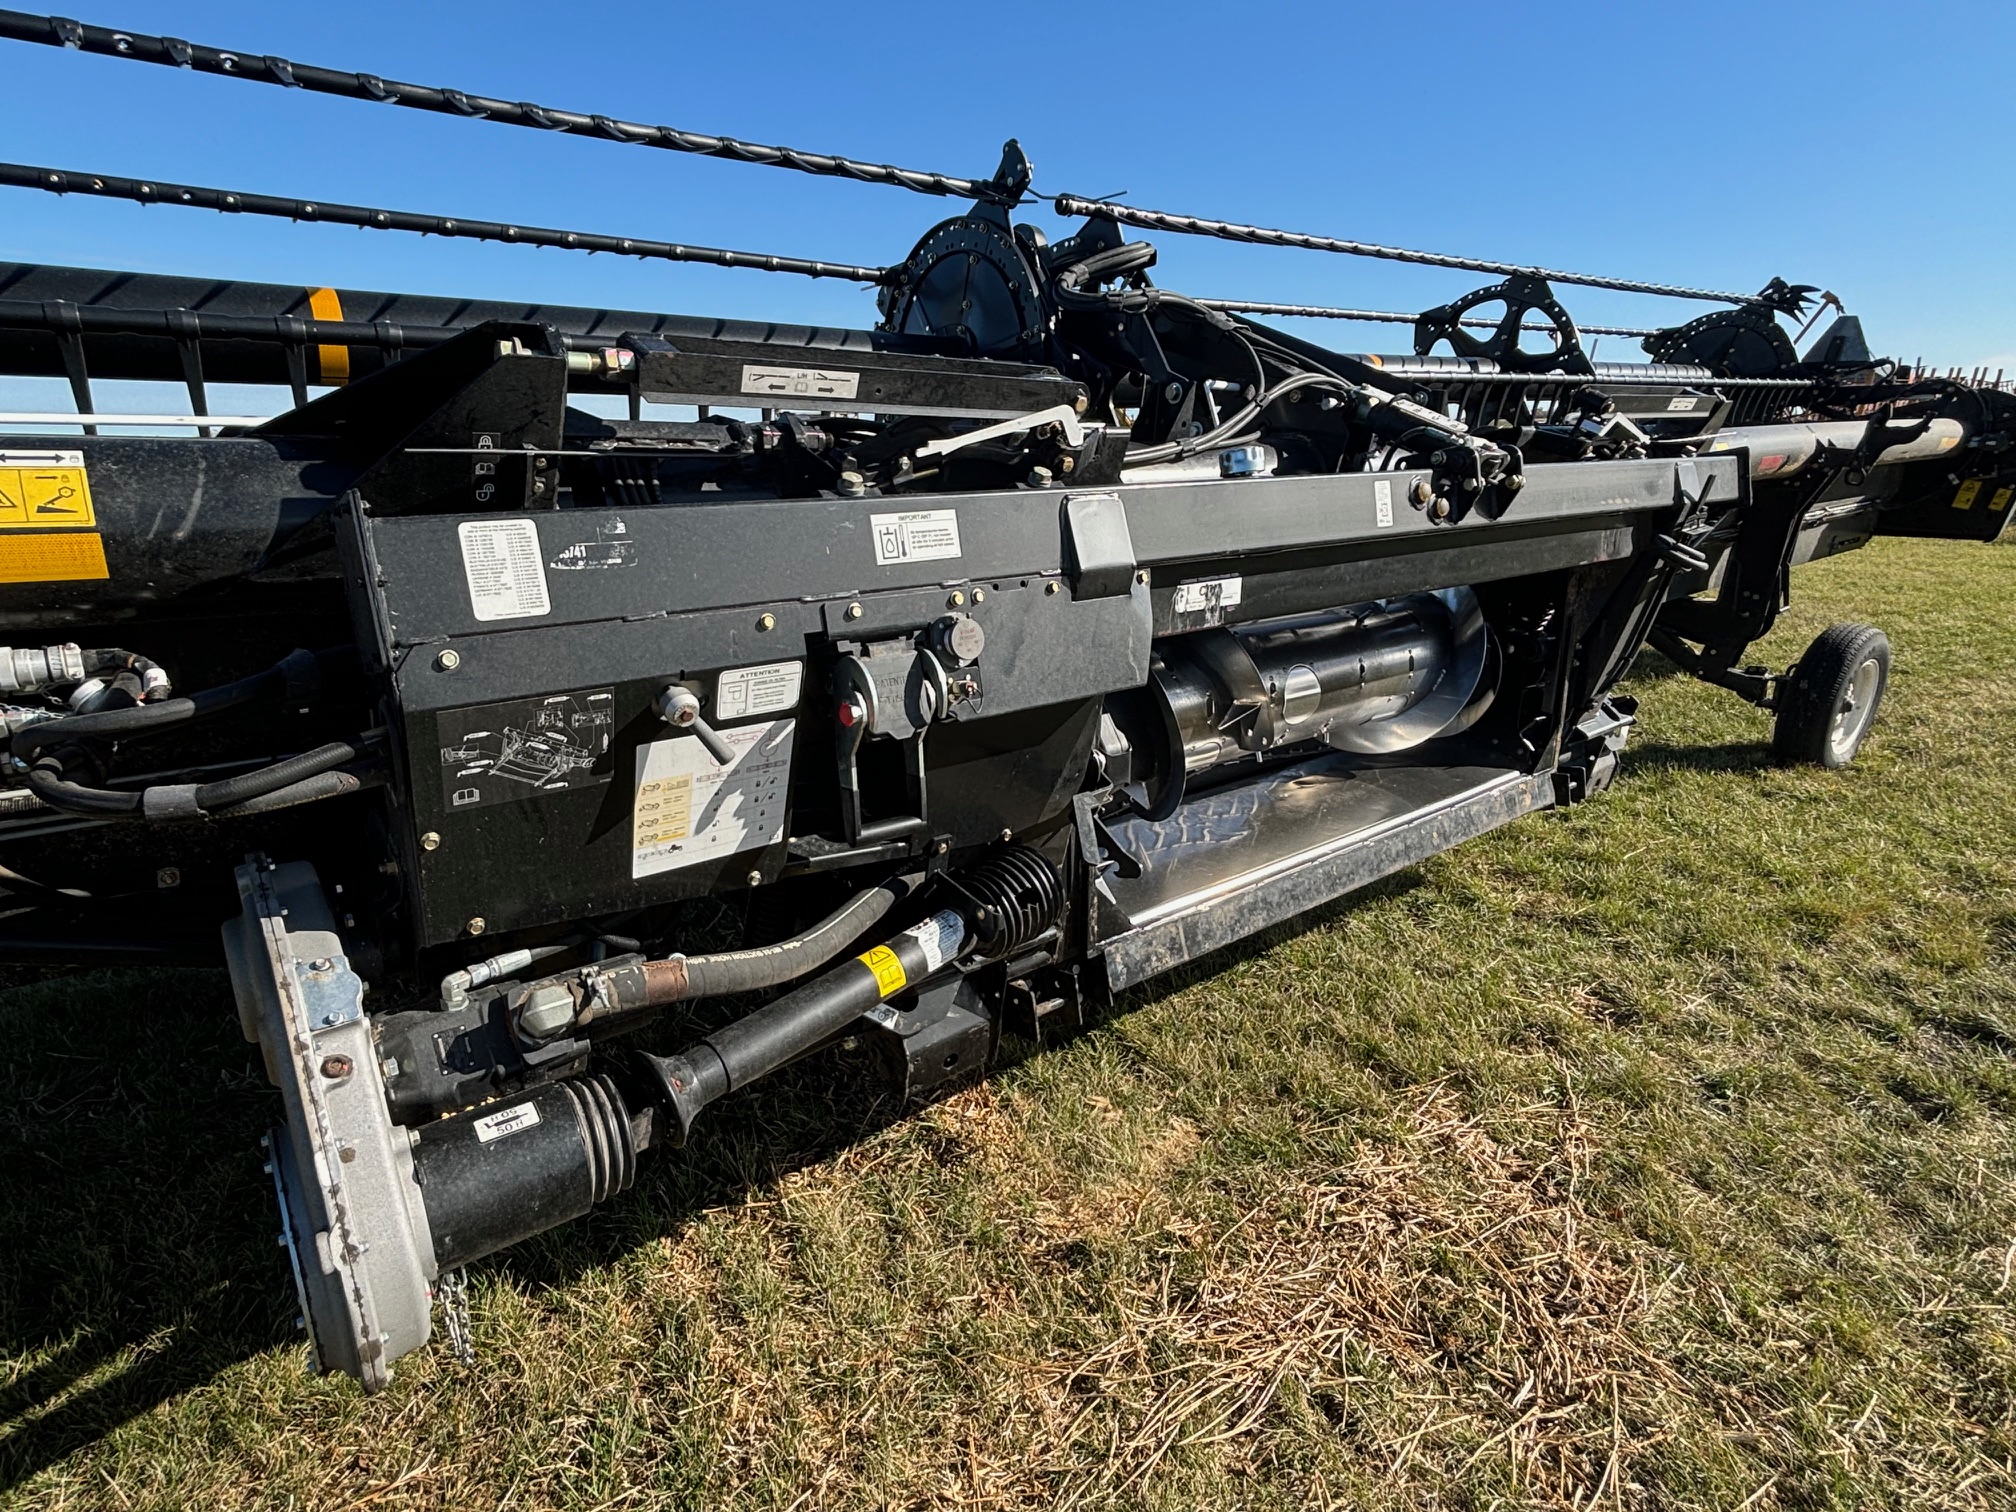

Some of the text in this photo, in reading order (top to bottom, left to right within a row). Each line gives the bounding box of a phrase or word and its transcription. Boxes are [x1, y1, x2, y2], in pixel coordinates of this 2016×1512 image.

[898, 513, 932, 521] IMPORTANT
[740, 669, 780, 679] ATTENTION
[497, 1123, 513, 1134] 50
